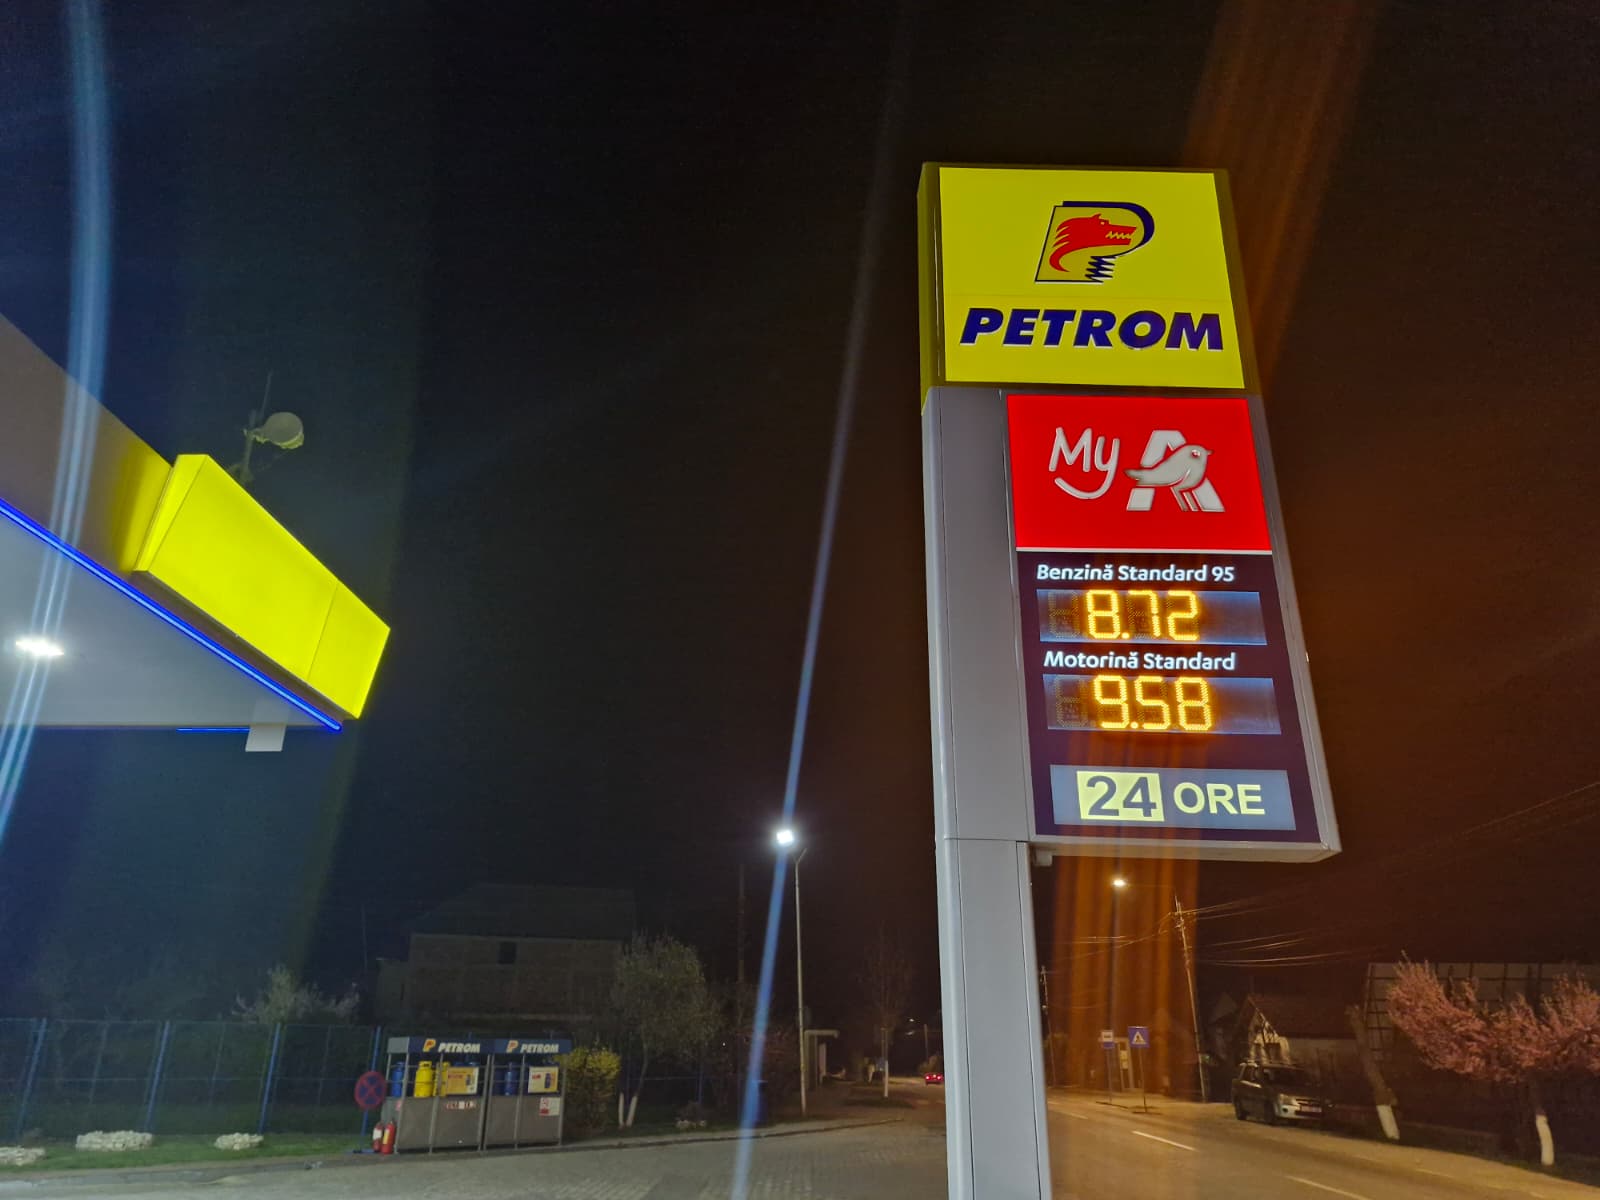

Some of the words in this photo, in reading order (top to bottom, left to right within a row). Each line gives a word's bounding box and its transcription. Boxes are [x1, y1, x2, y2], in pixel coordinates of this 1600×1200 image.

[960, 308, 1223, 350] PETROM
[1049, 427, 1119, 499] My
[1037, 565, 1113, 581] Benzină
[1118, 566, 1207, 582] Standard
[1212, 567, 1235, 582] 95
[1086, 589, 1199, 641] 8.72
[1043, 651, 1139, 669] Motorină
[1143, 652, 1236, 670] Standard
[1093, 674, 1212, 731] 9.58
[1085, 776, 1157, 818] 24
[1173, 782, 1266, 815] ORE
[438, 1042, 480, 1053] PETROM
[520, 1043, 559, 1053] PETROM
